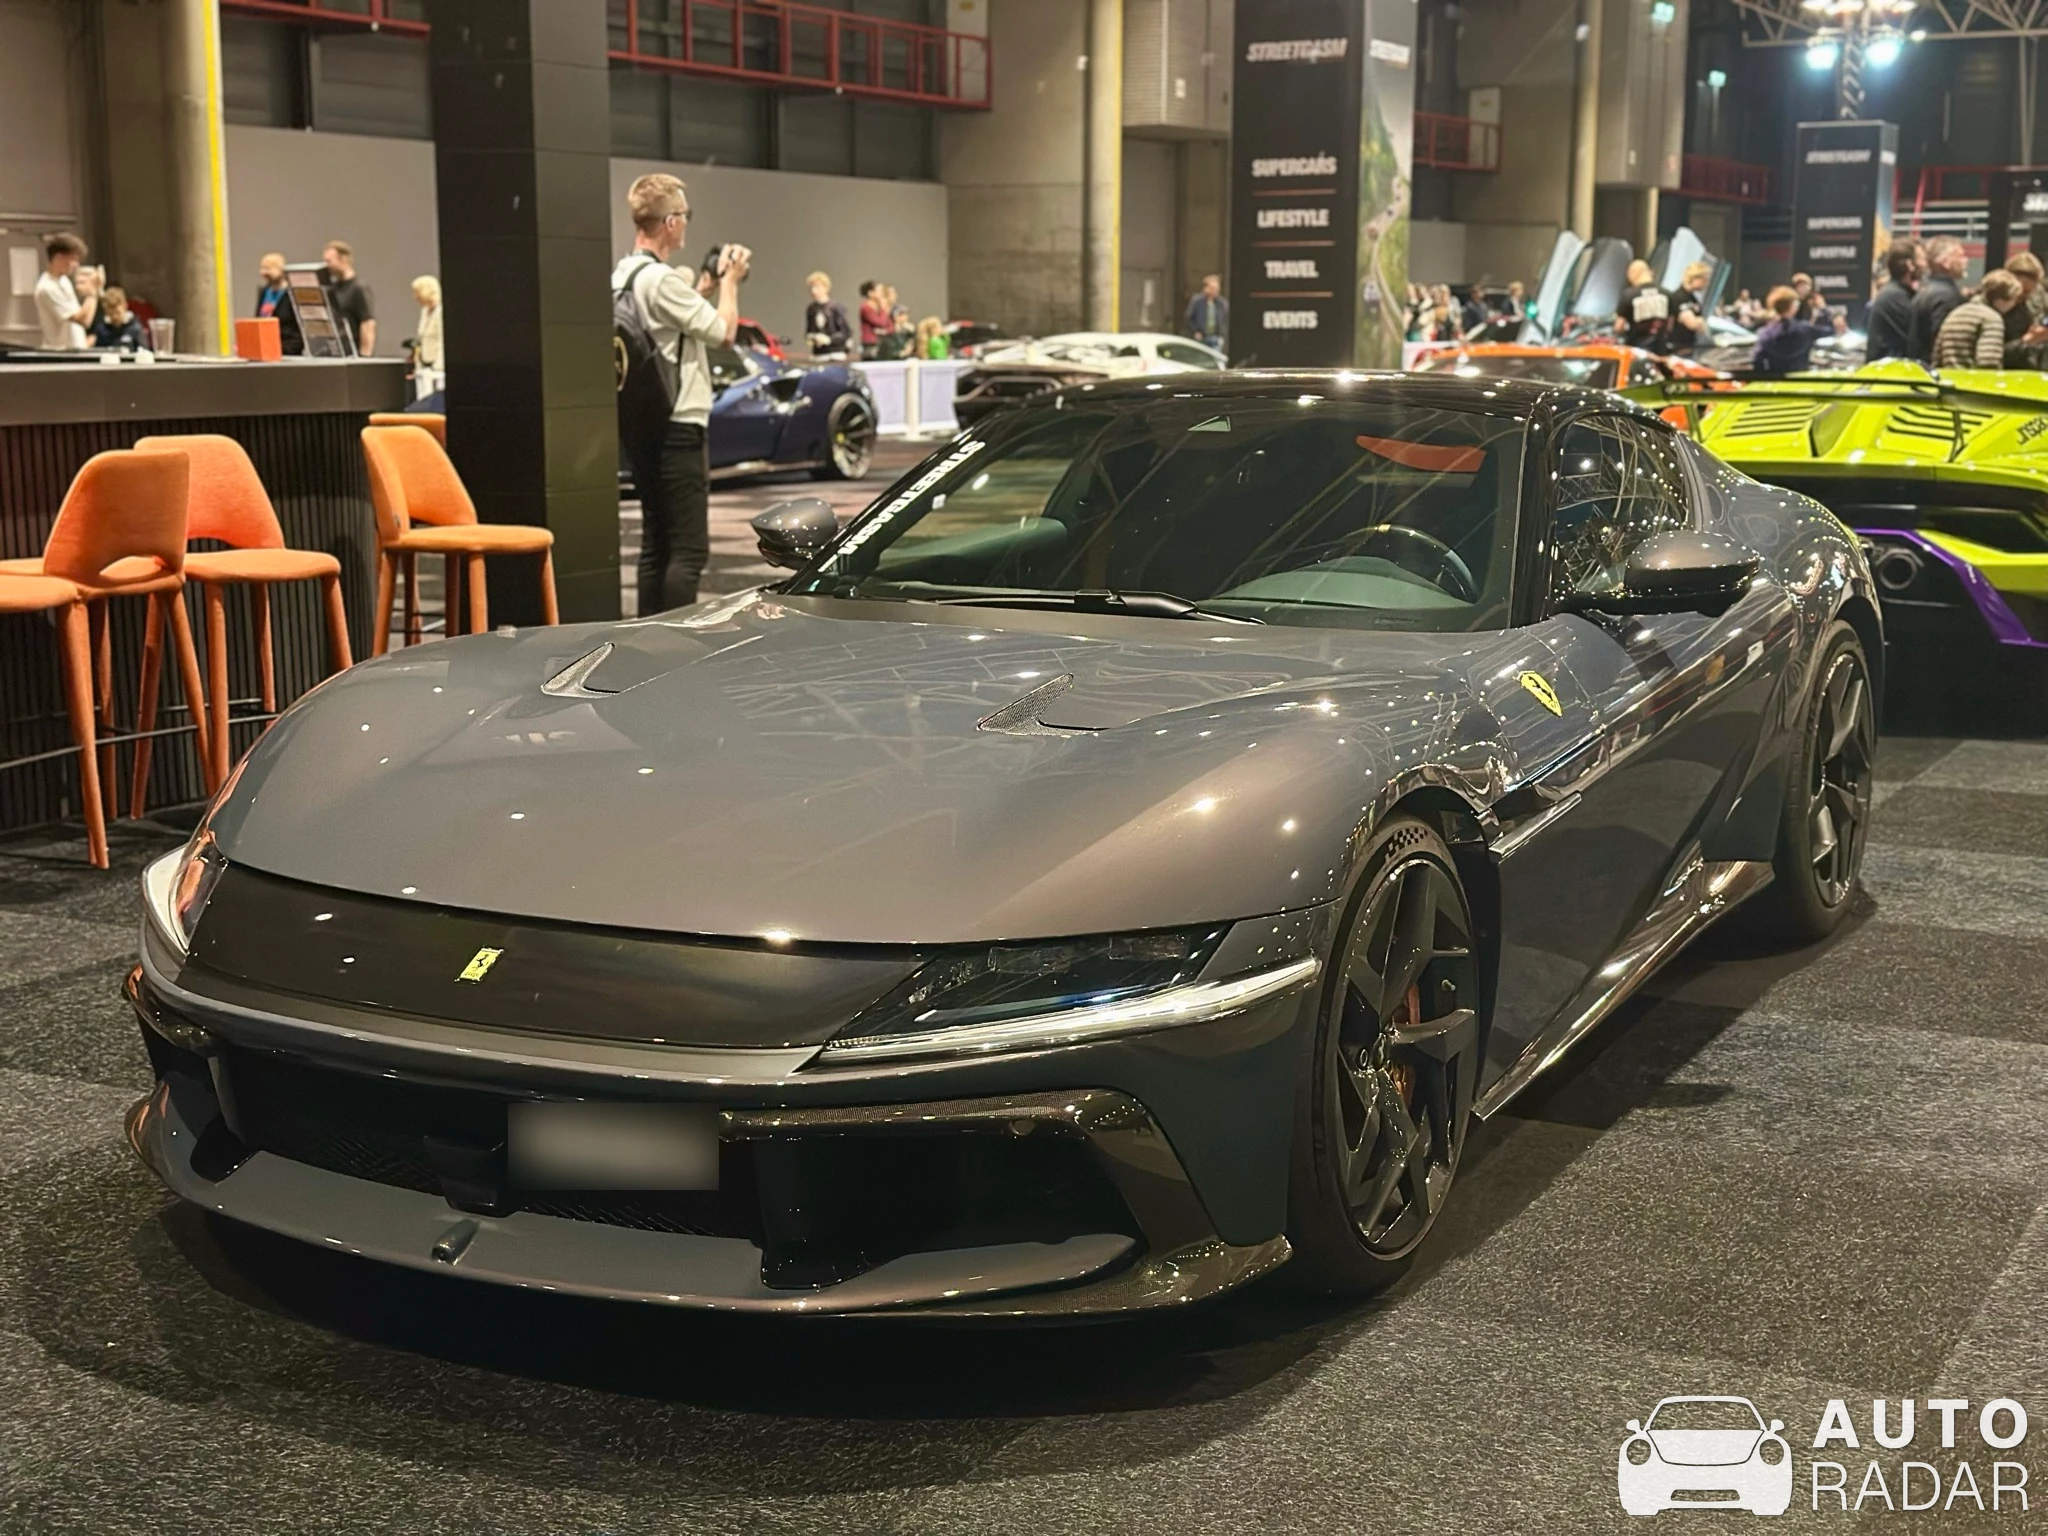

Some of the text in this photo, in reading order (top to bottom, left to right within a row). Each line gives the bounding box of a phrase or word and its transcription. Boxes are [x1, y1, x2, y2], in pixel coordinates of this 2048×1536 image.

[1252, 156, 1337, 177] SUPERCARS
[1257, 208, 1329, 228] LIFESTYLE
[1264, 260, 1319, 278] TRAVEL
[1263, 310, 1318, 329] EVENTS
